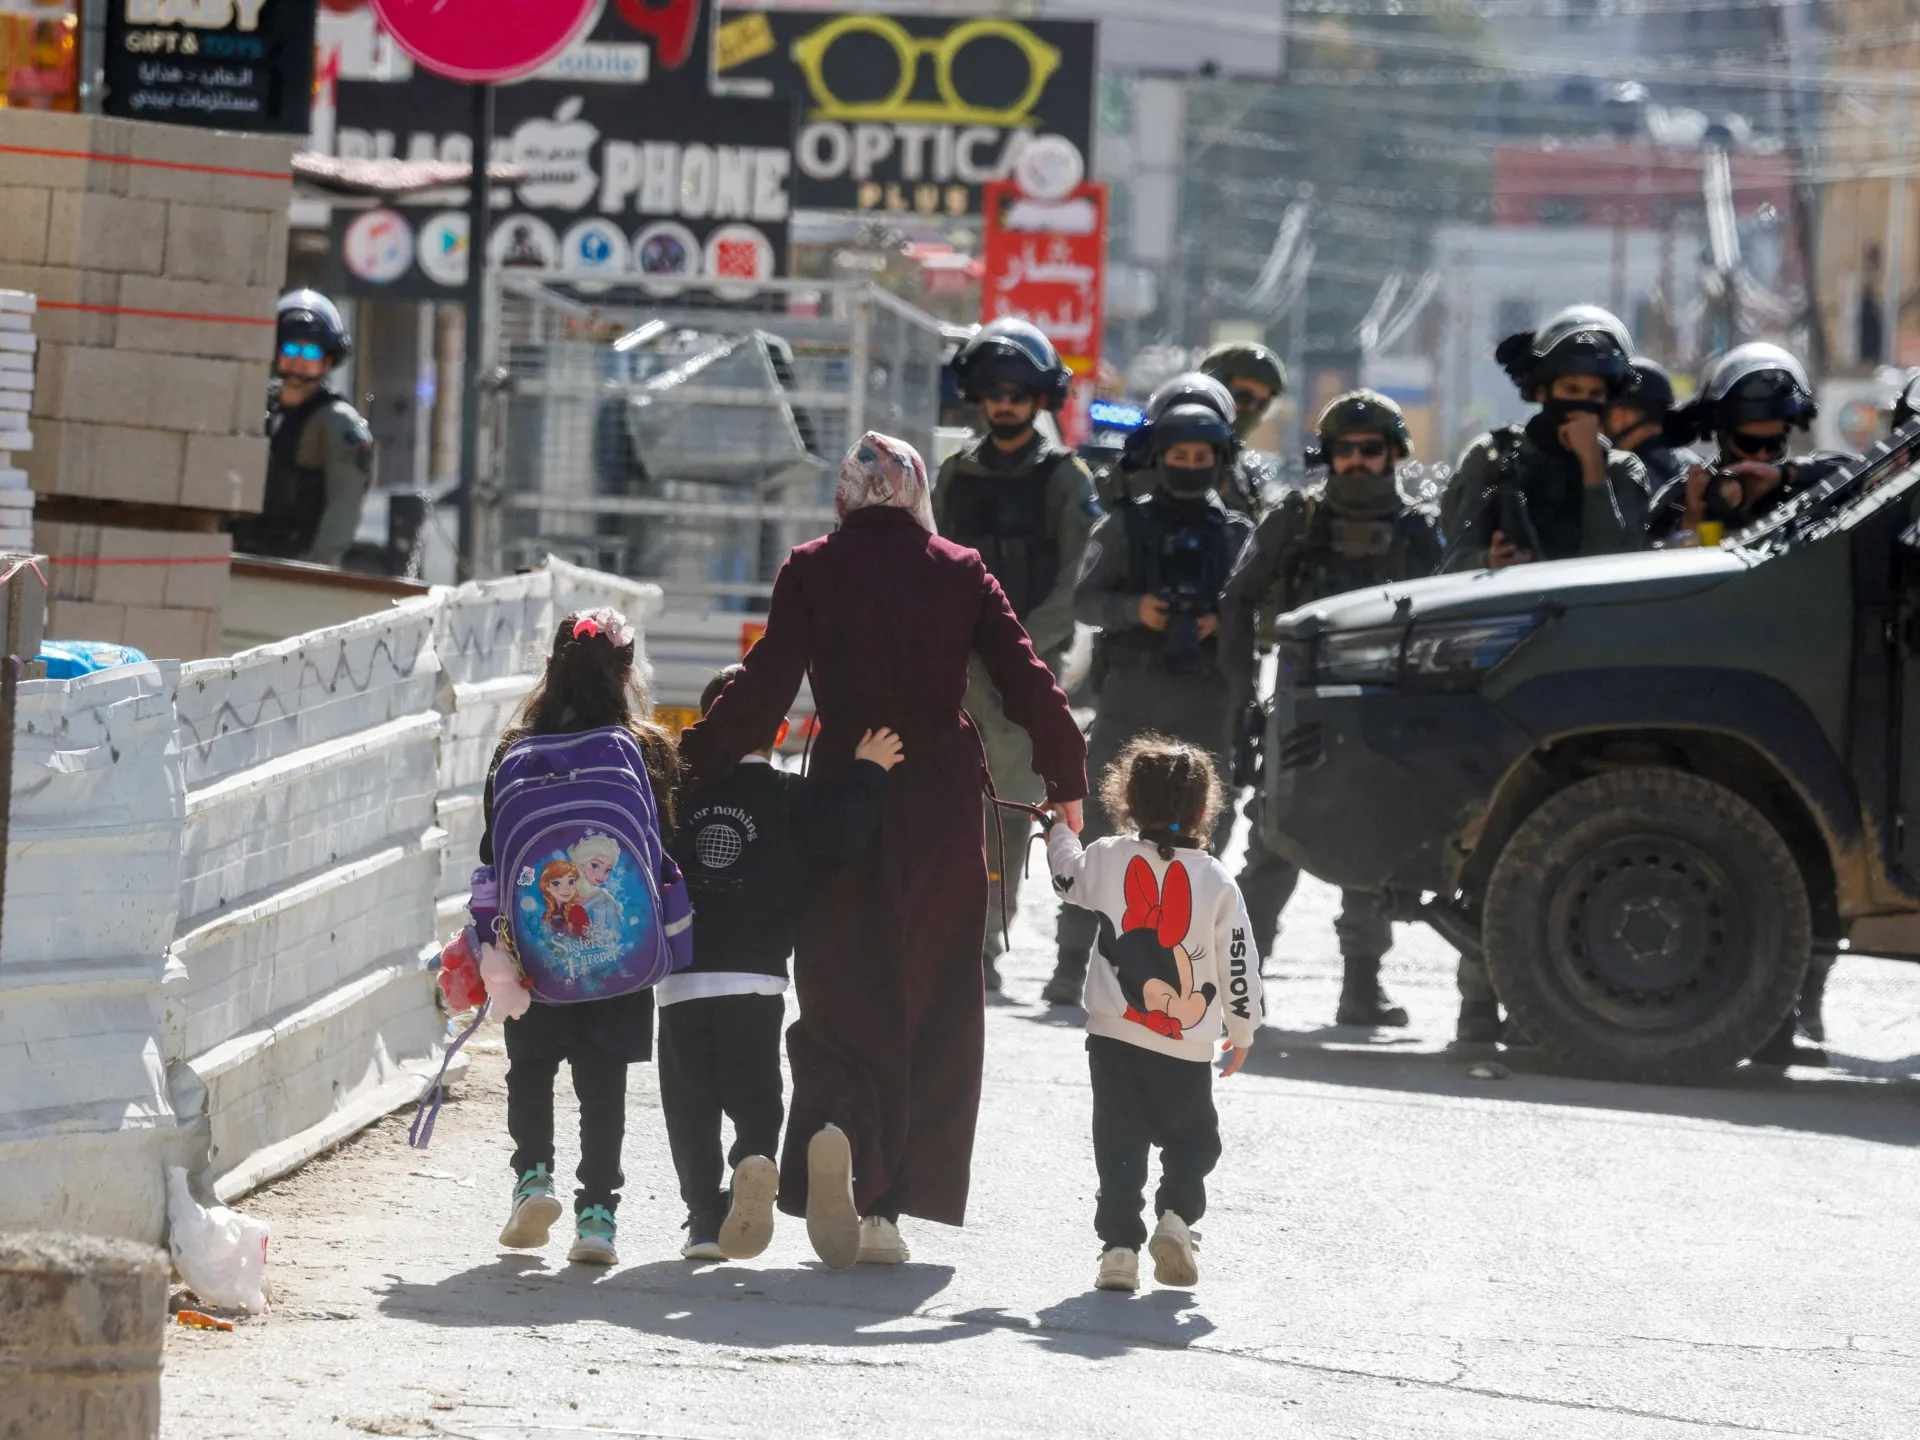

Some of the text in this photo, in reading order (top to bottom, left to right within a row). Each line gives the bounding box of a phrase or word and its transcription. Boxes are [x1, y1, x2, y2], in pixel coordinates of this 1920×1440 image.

[125, 31, 180, 53] GIFT
[180, 32, 199, 54] &
[600, 139, 792, 222] PHONE
[858, 182, 969, 215] PLUS
[712, 805, 758, 842] nothing
[1229, 927, 1251, 1020] MOUSE
